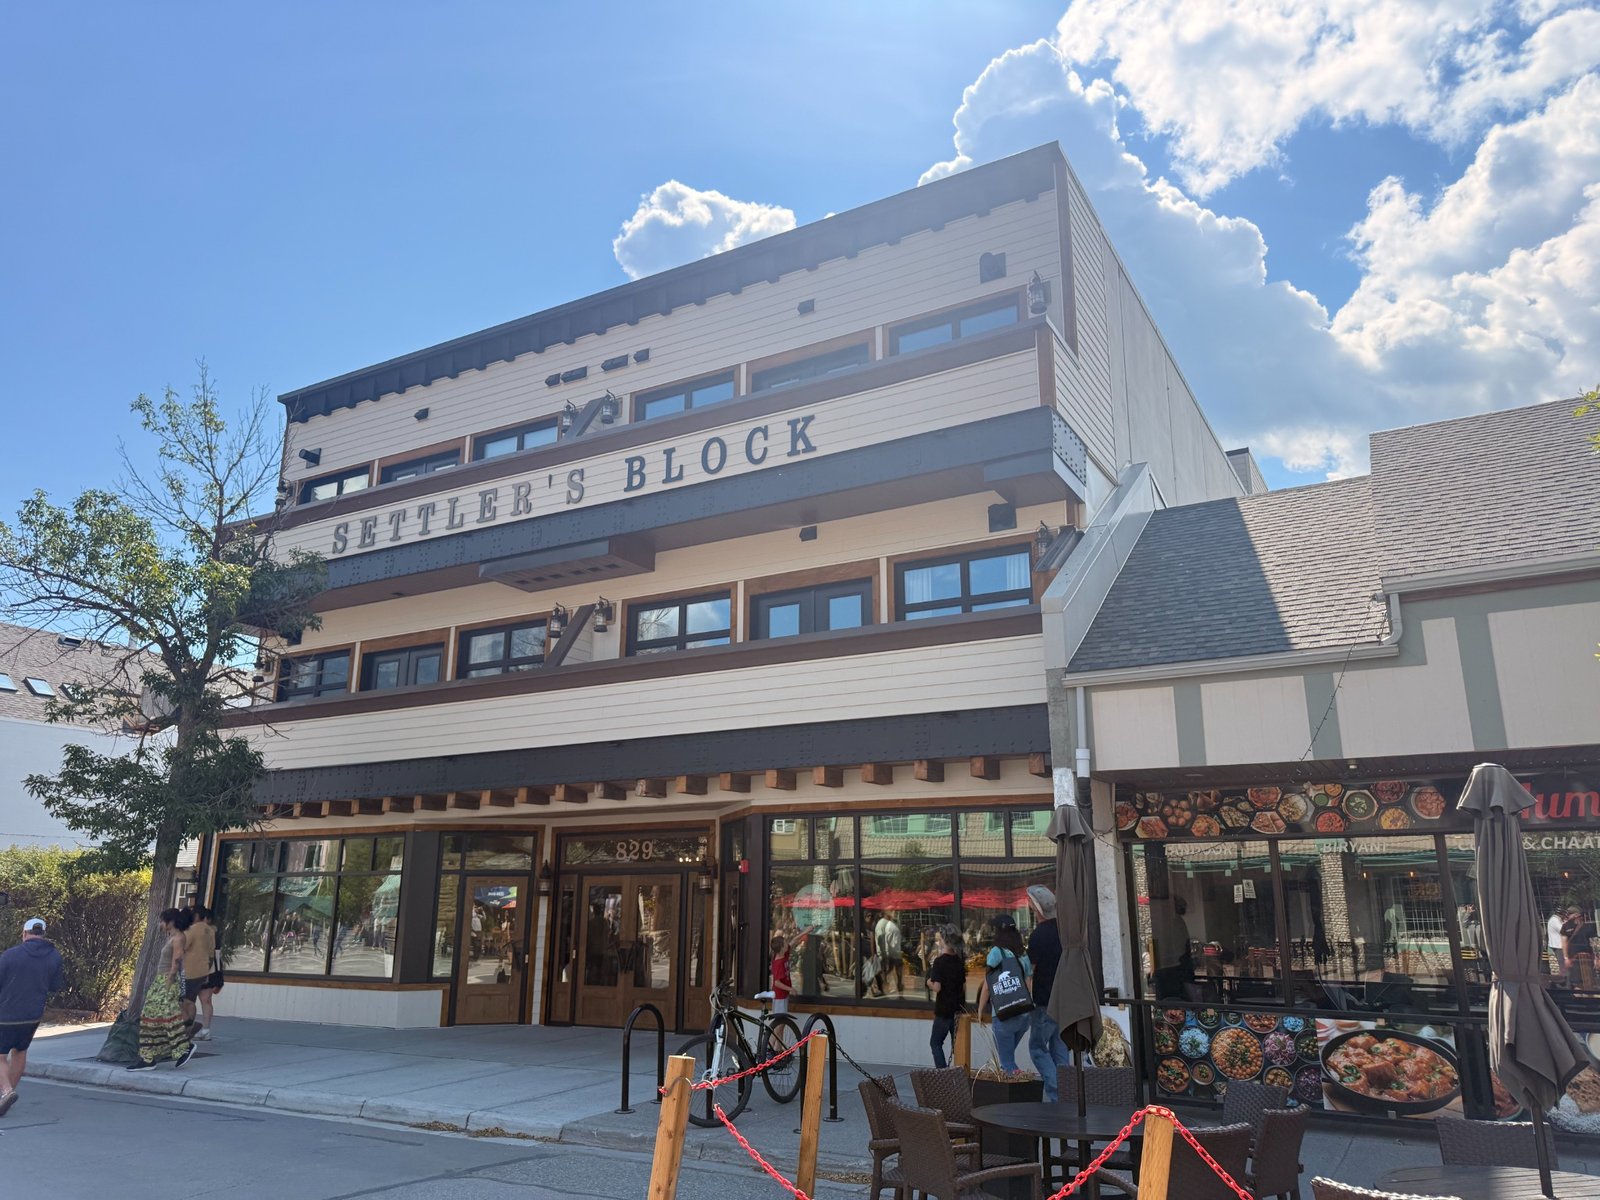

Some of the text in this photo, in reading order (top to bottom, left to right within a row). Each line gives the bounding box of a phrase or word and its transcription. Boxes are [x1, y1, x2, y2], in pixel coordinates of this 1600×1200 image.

[332, 415, 817, 554] SETTLER'S BLOCK
[616, 841, 653, 860] 829
[1323, 840, 1387, 853] BIRYANI
[993, 977, 1021, 994] BIG BEAR
